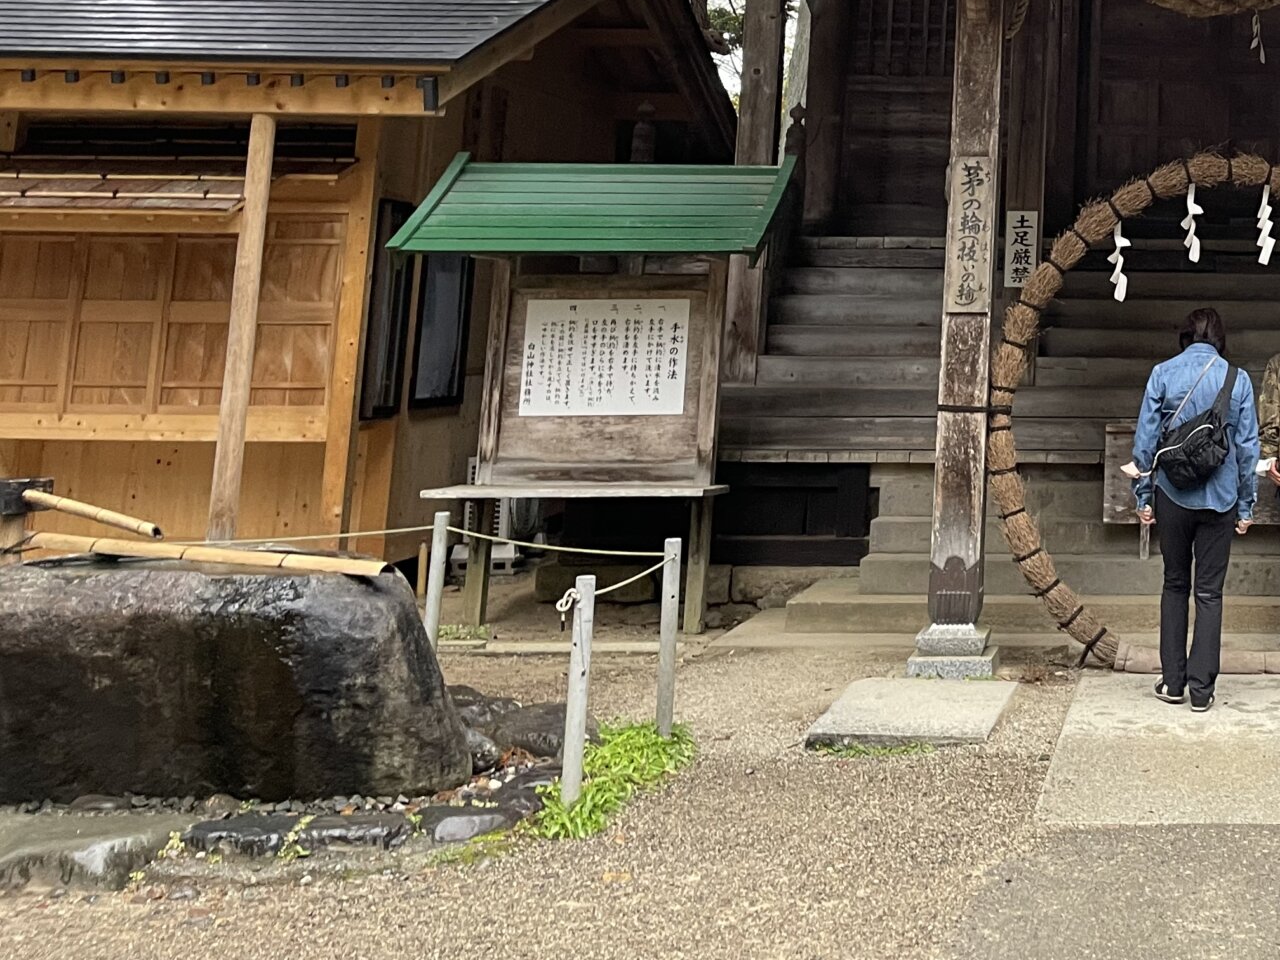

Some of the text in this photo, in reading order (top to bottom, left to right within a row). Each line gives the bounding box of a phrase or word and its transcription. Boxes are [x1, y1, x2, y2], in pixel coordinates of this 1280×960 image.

[1011, 215, 1033, 283] 土足厳禁
[523, 342, 536, 406] 白山神社社務所
[667, 322, 681, 380] 手水の作法
